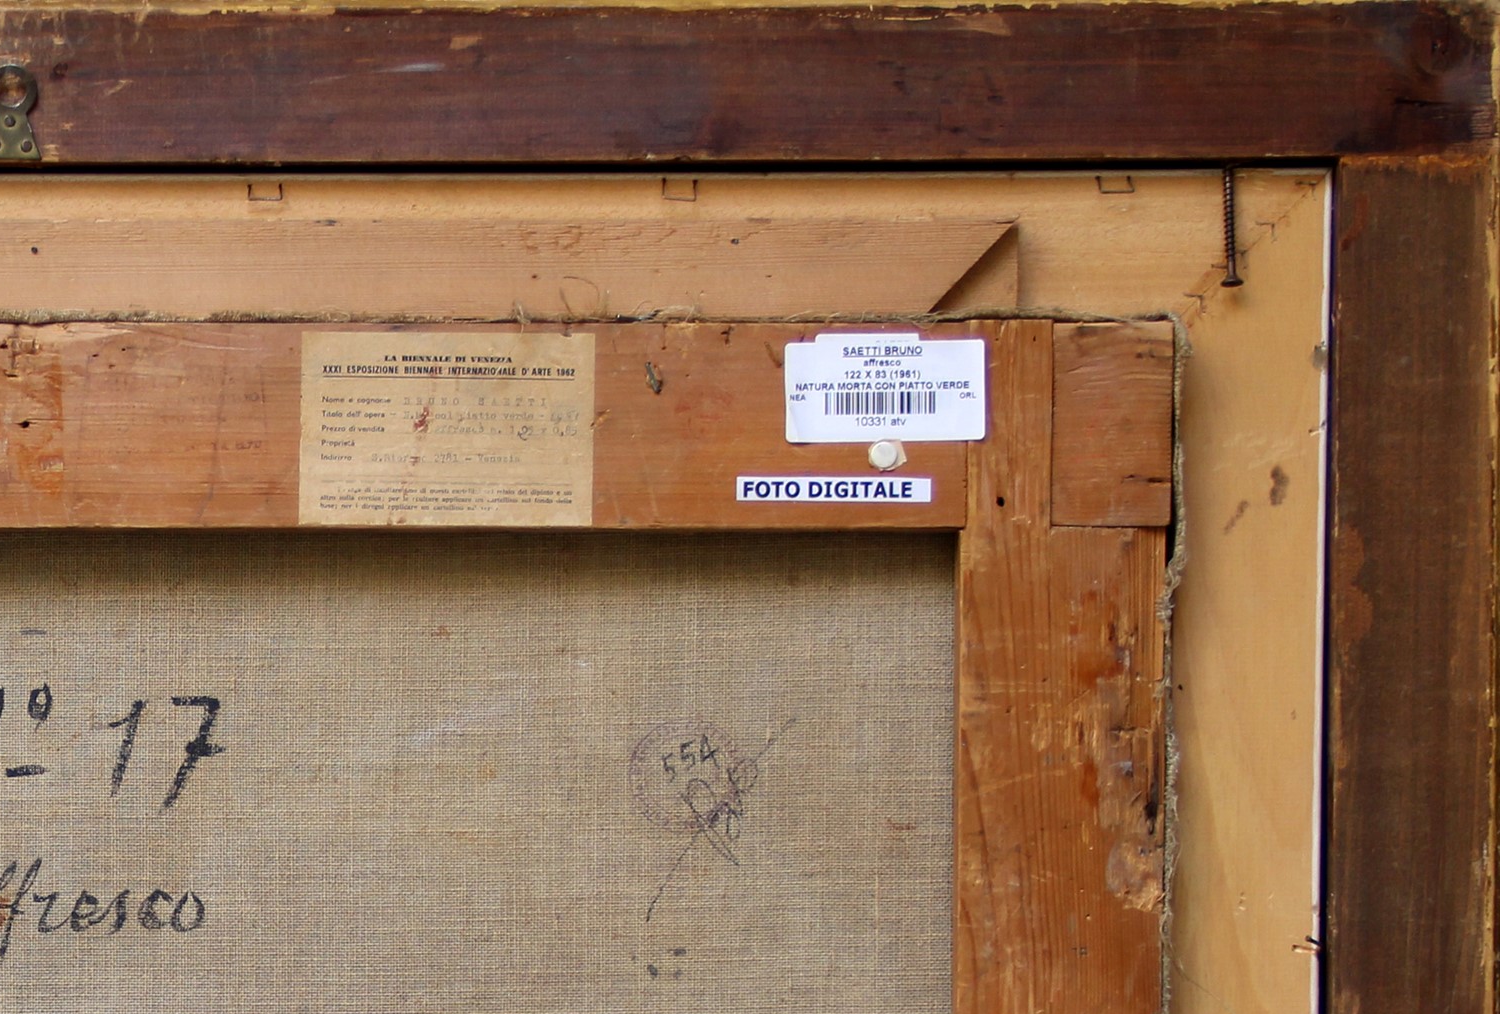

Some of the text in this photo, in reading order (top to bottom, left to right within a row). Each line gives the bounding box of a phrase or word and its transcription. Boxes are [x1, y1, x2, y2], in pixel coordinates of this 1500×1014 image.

[843, 346, 923, 356] SAETTI BRUNO
[402, 355, 451, 363] BIENNALE
[863, 359, 902, 367] affresco
[322, 365, 342, 374] XXXI
[347, 366, 399, 375] ESPOSIZIONE
[404, 366, 443, 376] BIENNALE
[556, 368, 576, 377] 1962
[844, 370, 921, 380] 122 X 83 (1961)
[795, 381, 970, 392] NATURA MORTA CON PIATTO VERDE
[322, 396, 346, 404] Nome
[321, 410, 343, 418] Titolo
[364, 411, 386, 420] opera
[855, 417, 907, 427] 10331 atv
[321, 425, 346, 433] Prezzo
[357, 426, 385, 434] vendita
[743, 481, 913, 498] FOTO DIGITALE
[108, 696, 227, 815] 17
